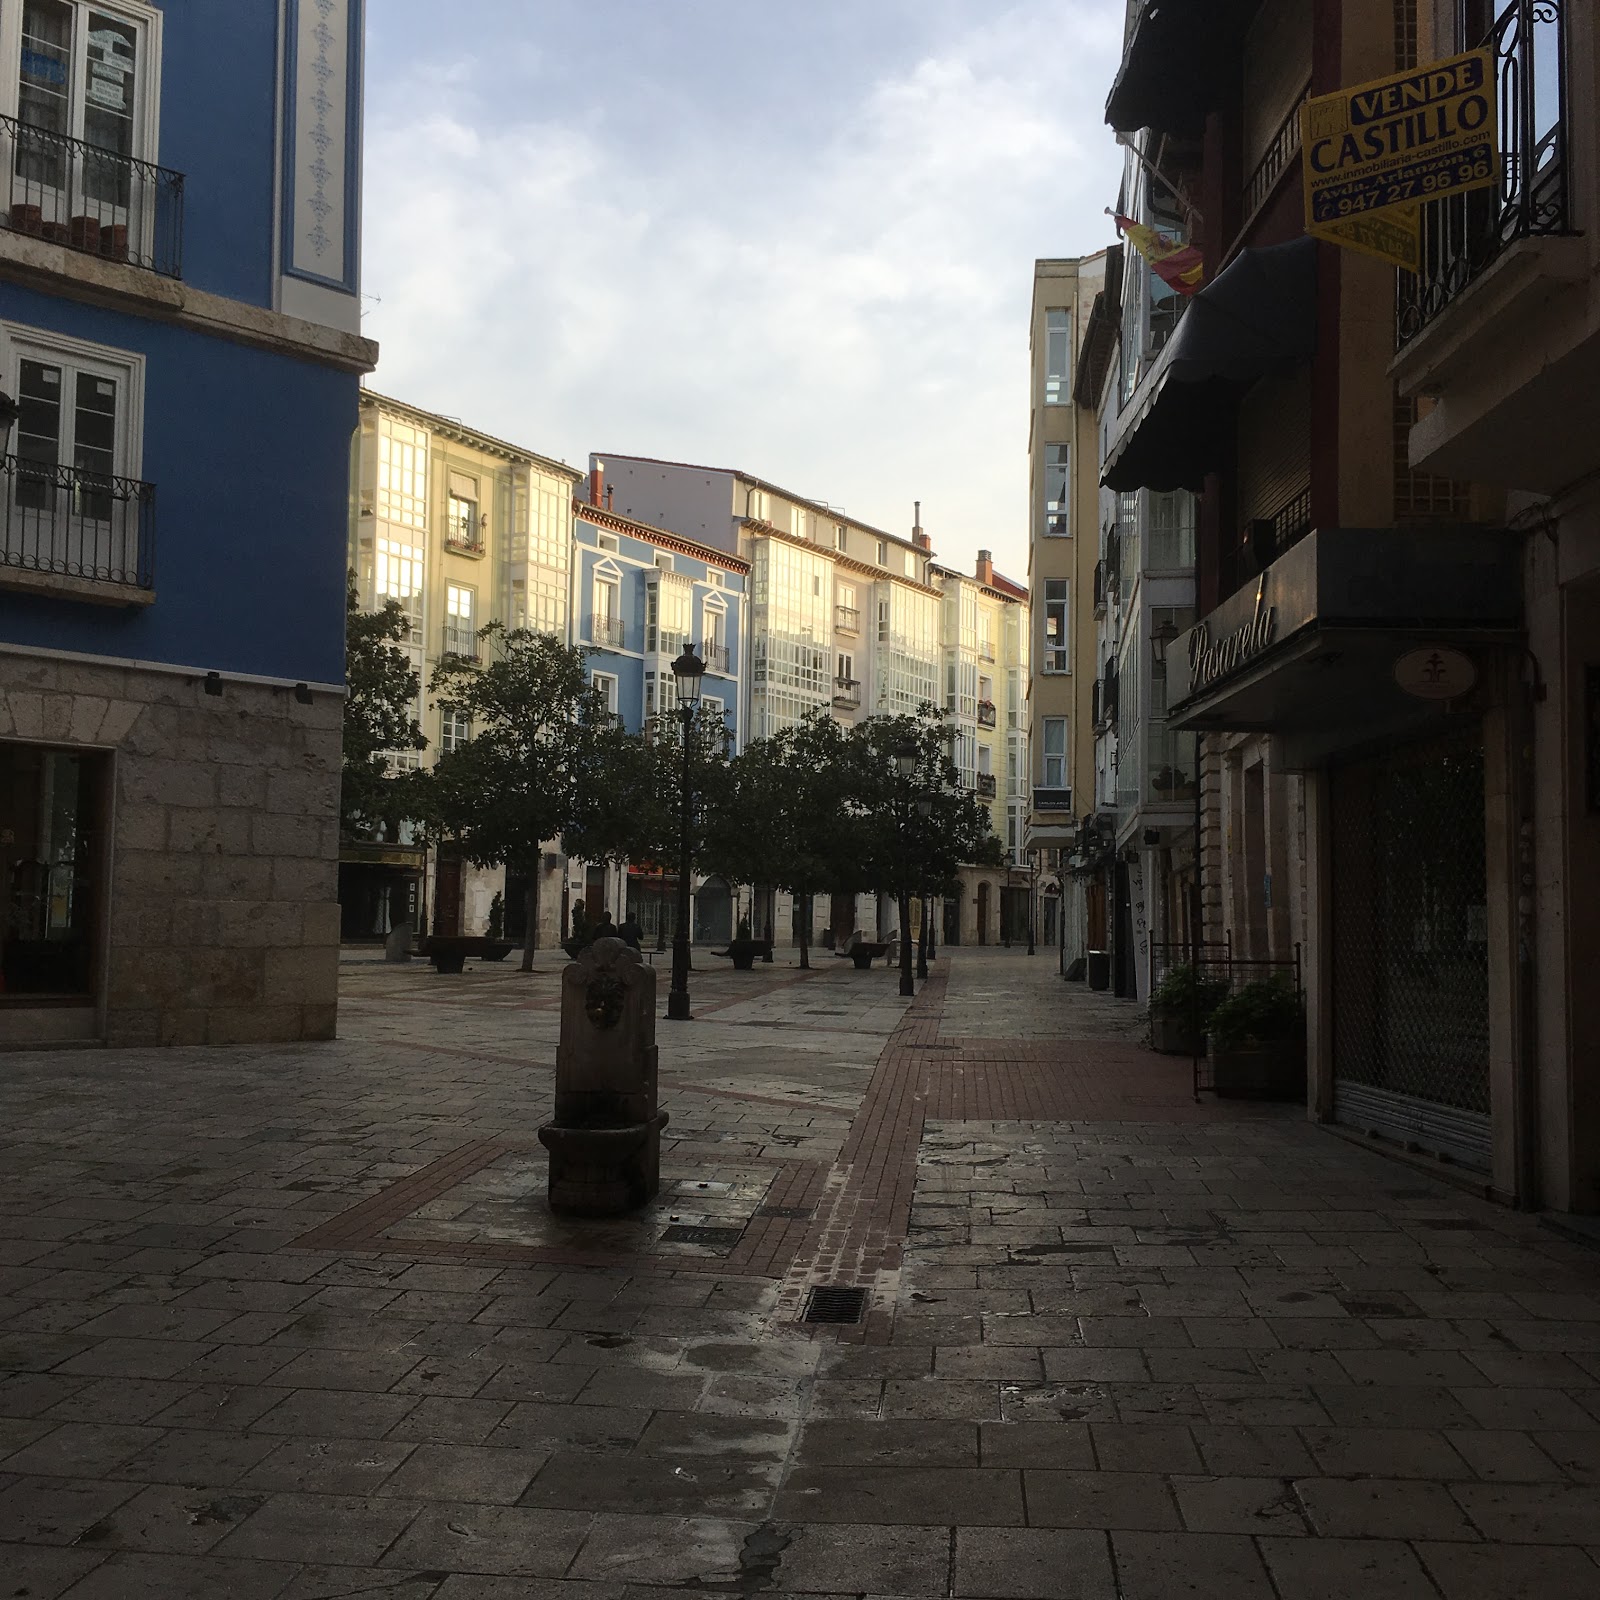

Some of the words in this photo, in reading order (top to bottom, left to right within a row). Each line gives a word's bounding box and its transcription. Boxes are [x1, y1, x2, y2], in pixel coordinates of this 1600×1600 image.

[1355, 62, 1475, 119] VENDE
[1311, 95, 1488, 173] CASTILLO
[1311, 130, 1490, 188] www.inmobiliaria-castillo.com
[1338, 190, 1380, 216] 947
[1387, 181, 1416, 202] 27
[1422, 173, 1451, 192] 96
[1458, 160, 1489, 181] 96
[1188, 571, 1275, 691] Pasarela
